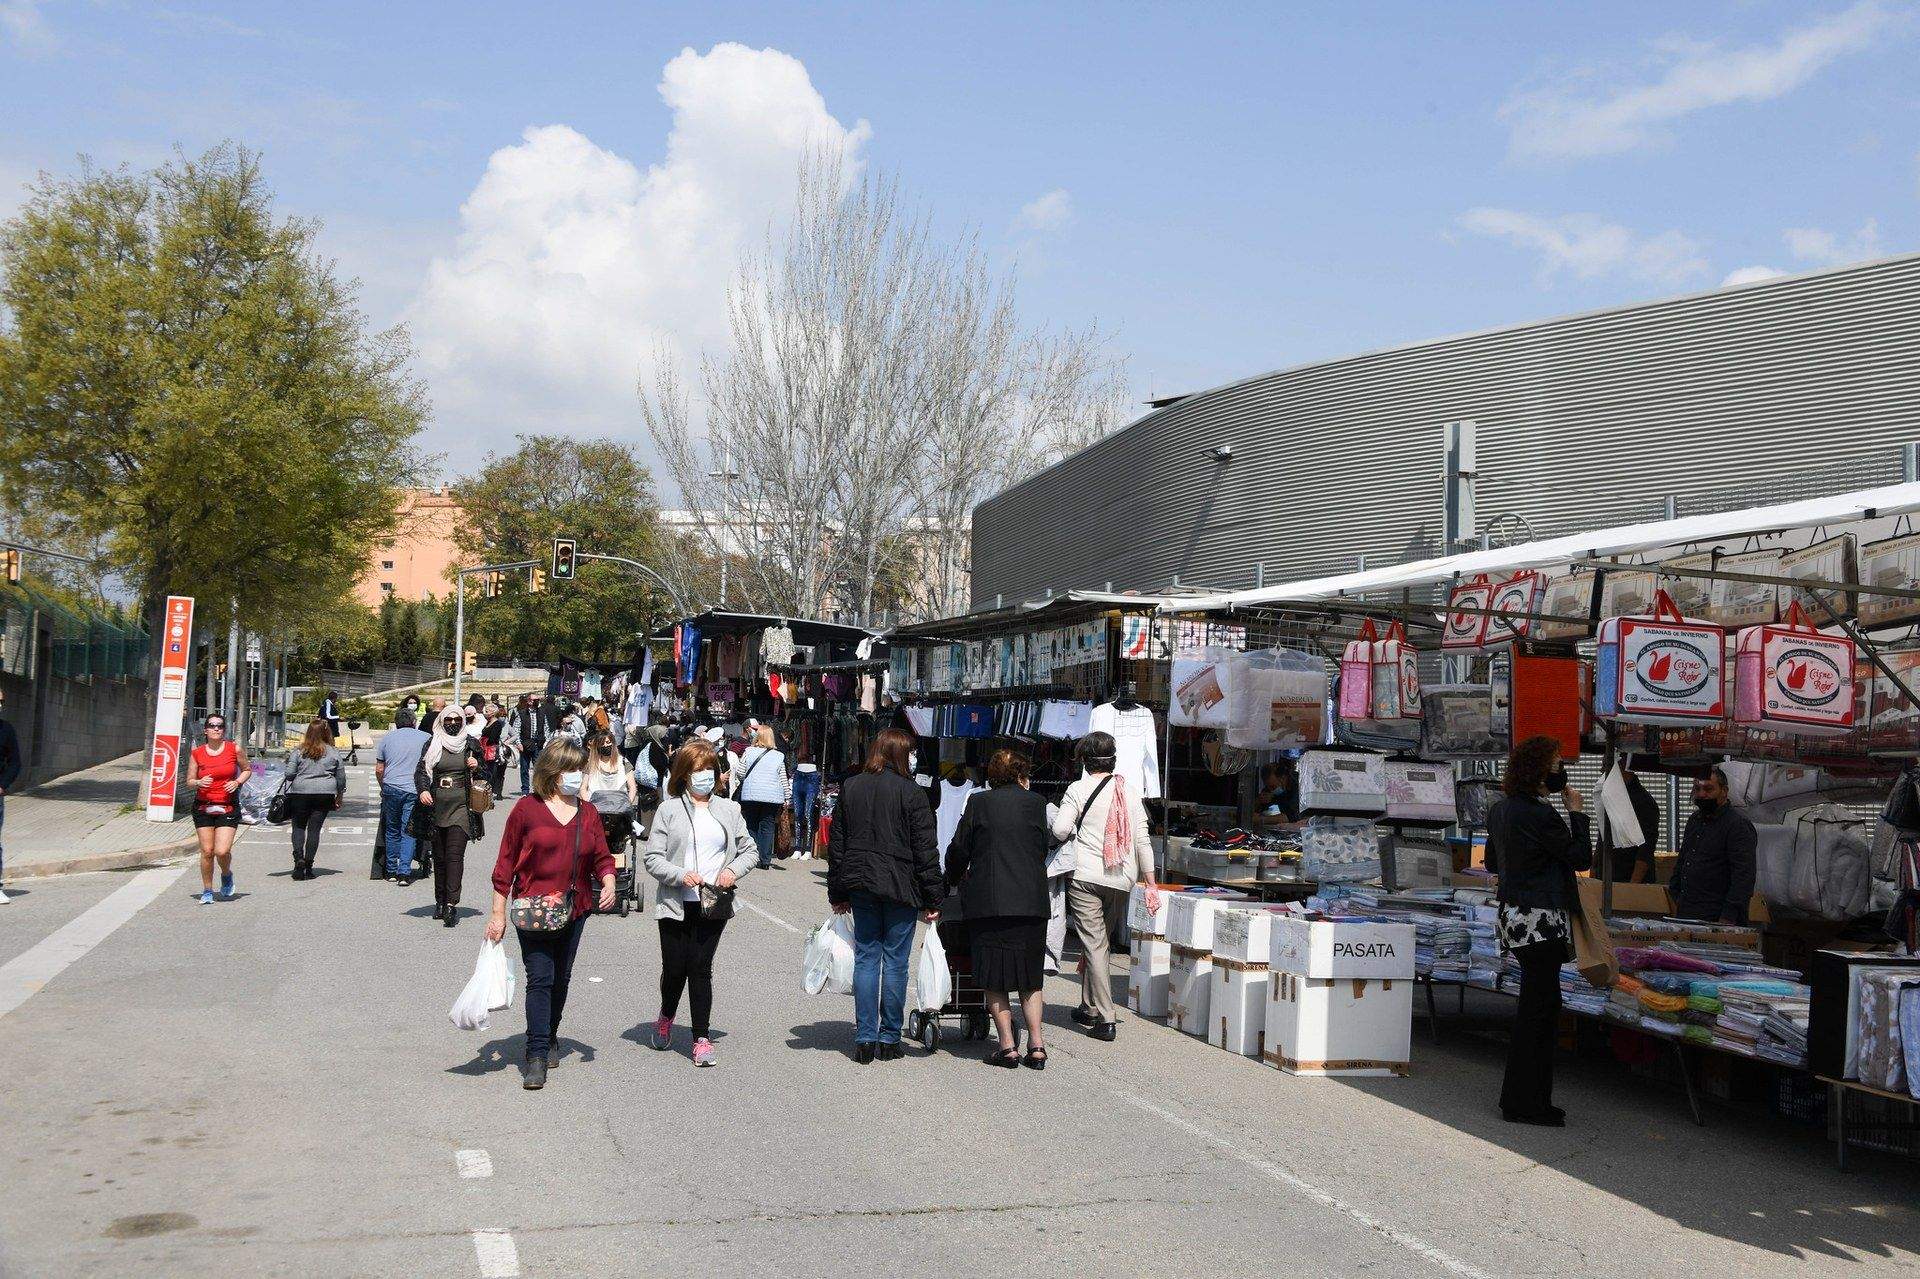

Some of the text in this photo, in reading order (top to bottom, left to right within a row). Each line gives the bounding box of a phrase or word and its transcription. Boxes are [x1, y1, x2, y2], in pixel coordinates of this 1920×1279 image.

[1643, 628, 1672, 636] SABANAS
[1680, 631, 1708, 639] INVIERNO
[1782, 637, 1808, 646] SABANAS
[1815, 641, 1840, 650] INVIERNO
[1678, 670, 1701, 685] Rojo
[1814, 680, 1834, 695] Rojo
[714, 691, 727, 701] 6€
[1333, 943, 1396, 958] PASATA
[1243, 963, 1269, 971] SIRENA
[1346, 1061, 1373, 1069] SIRENA
